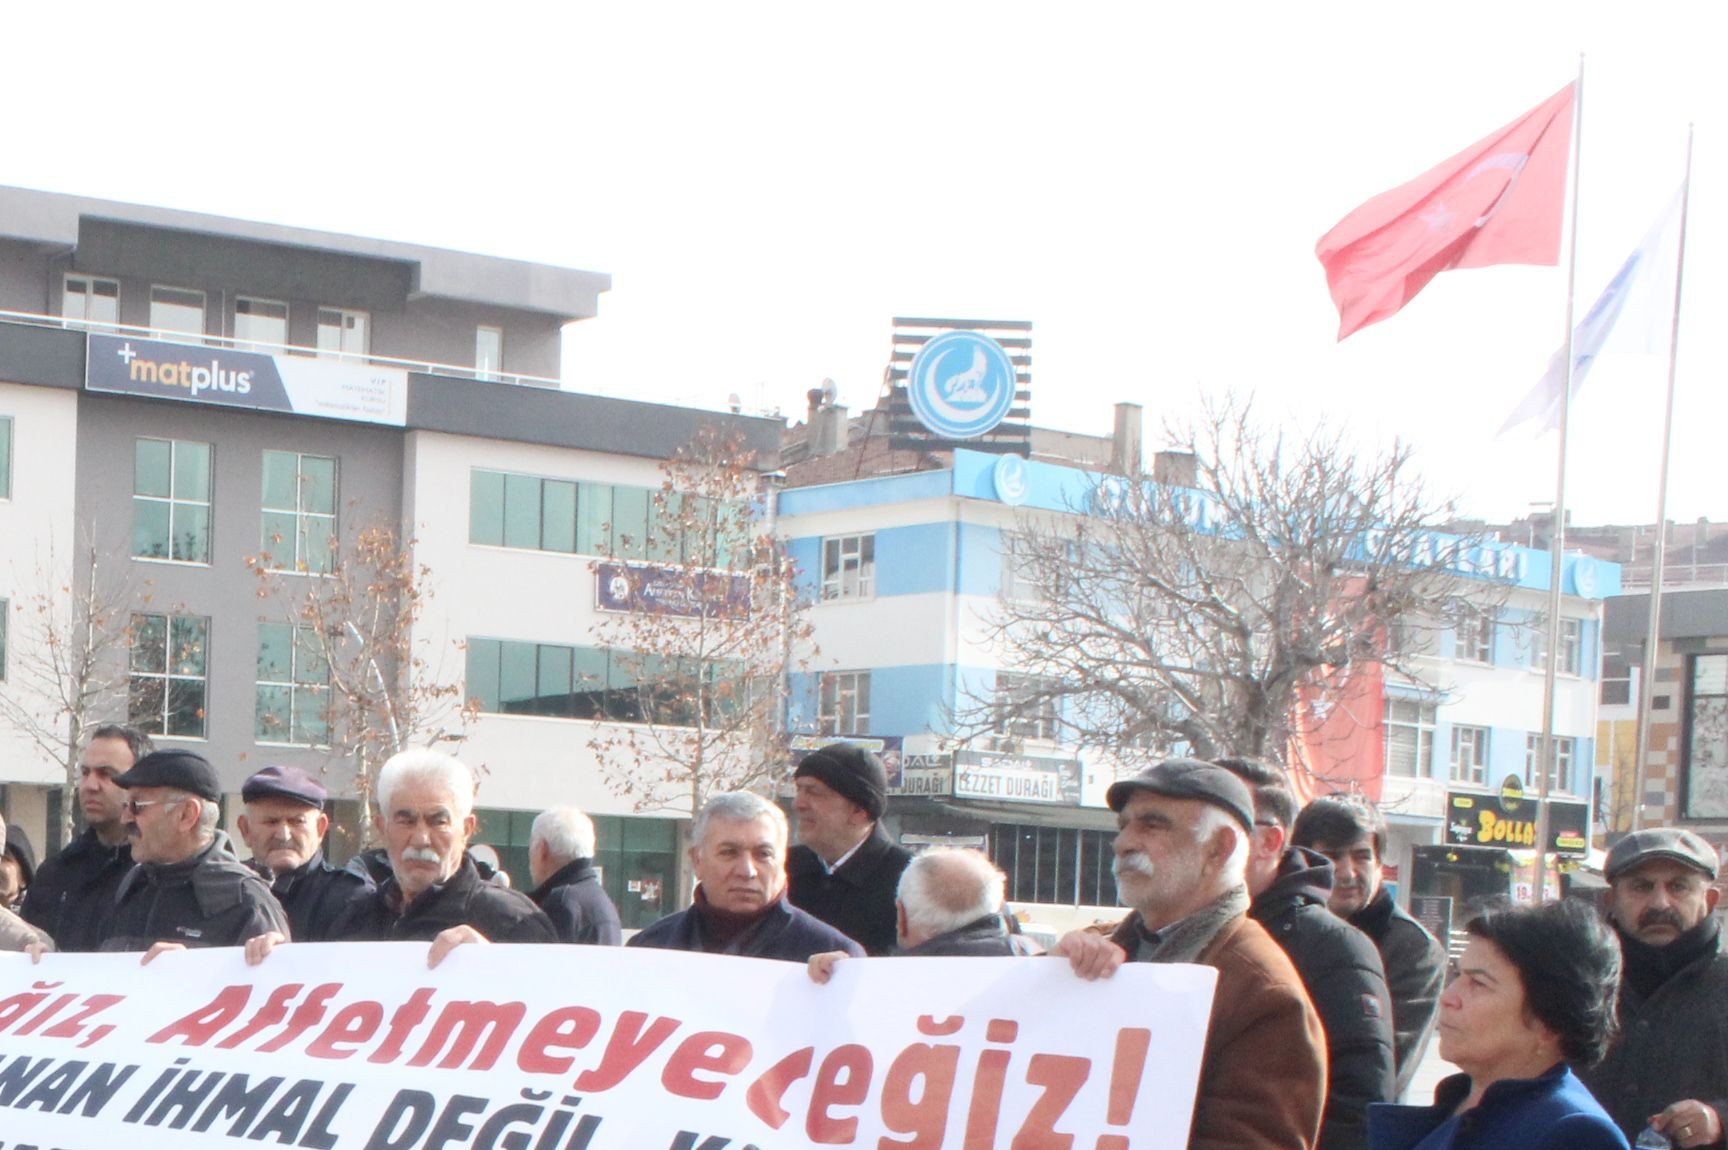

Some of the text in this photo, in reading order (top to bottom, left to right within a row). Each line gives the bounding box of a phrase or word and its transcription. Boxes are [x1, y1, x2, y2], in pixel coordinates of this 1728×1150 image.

[958, 770, 1002, 794] LEZZET
[1006, 773, 1054, 798] DURAĞI
[1477, 810, 1537, 846] BOLLA
[123, 1057, 356, 1150] İHMAL
